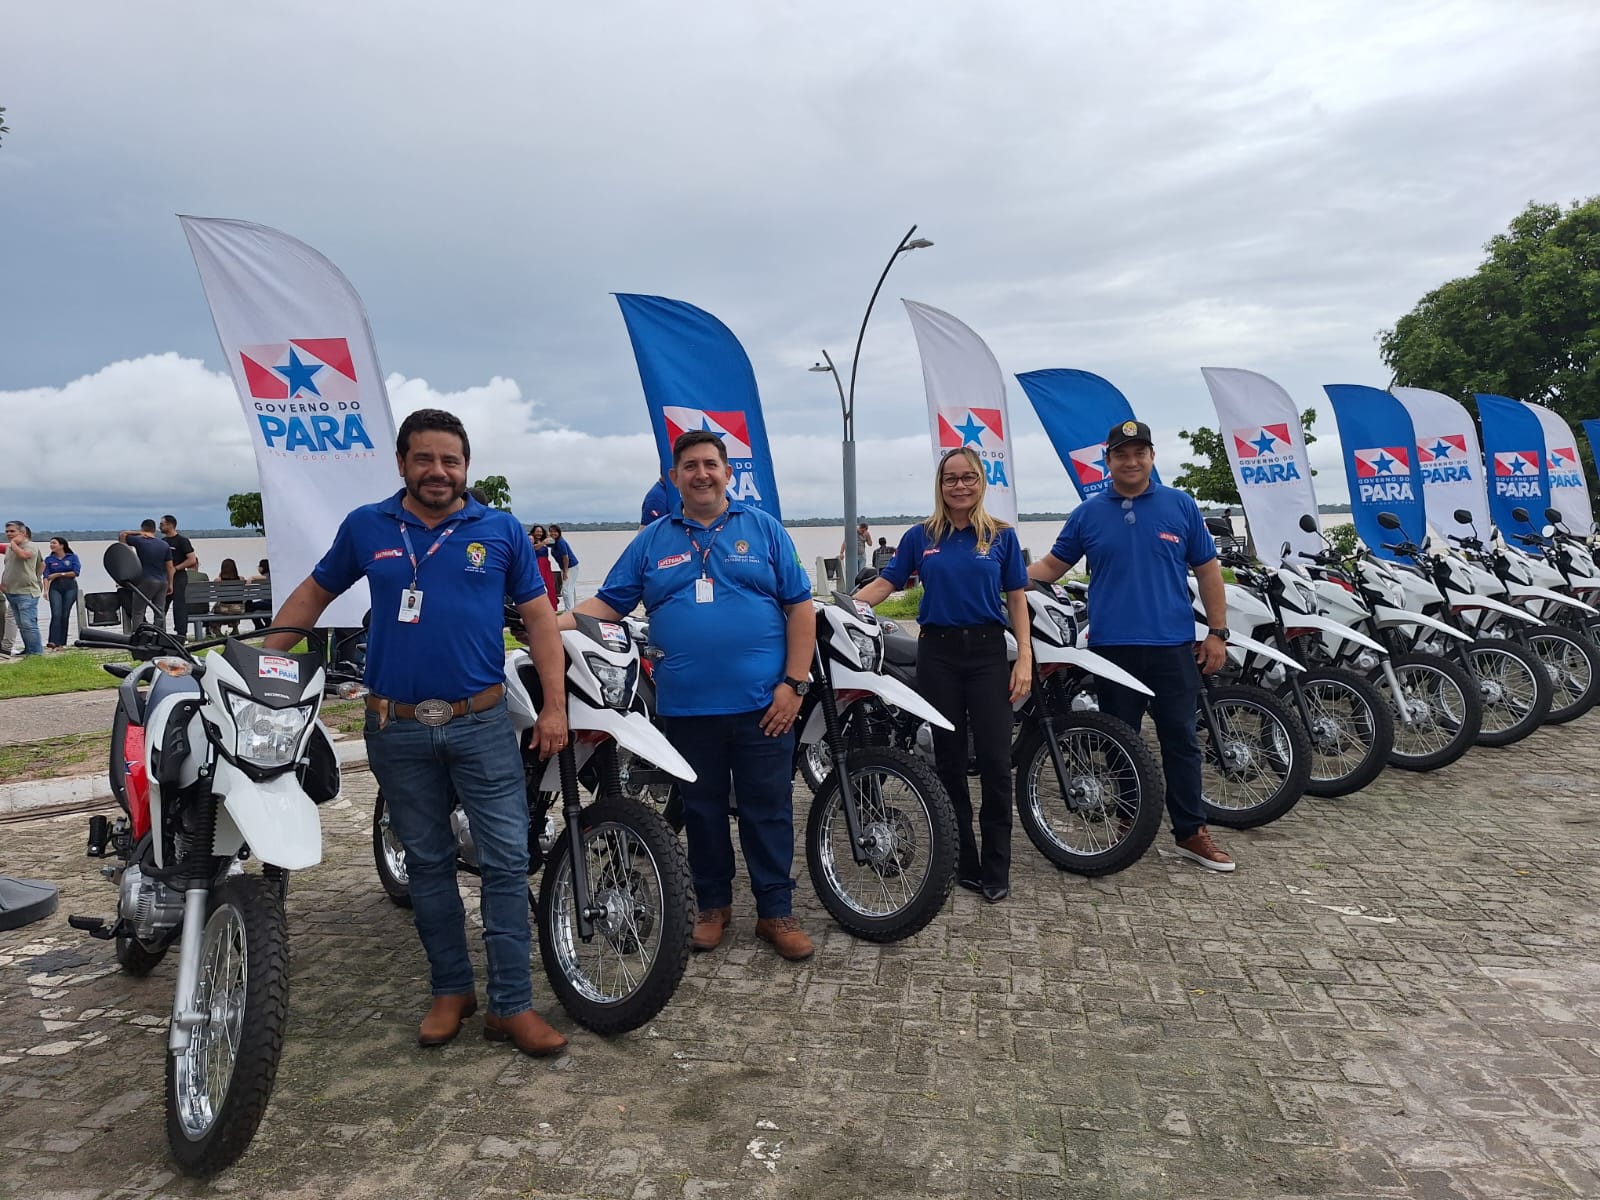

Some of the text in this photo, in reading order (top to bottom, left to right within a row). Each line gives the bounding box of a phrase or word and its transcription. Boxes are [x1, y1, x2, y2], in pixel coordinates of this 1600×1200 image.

[254, 401, 361, 413] GOVERNO DO
[991, 451, 1004, 459] DO
[735, 461, 753, 470] DO
[1082, 480, 1114, 493] GOVE
